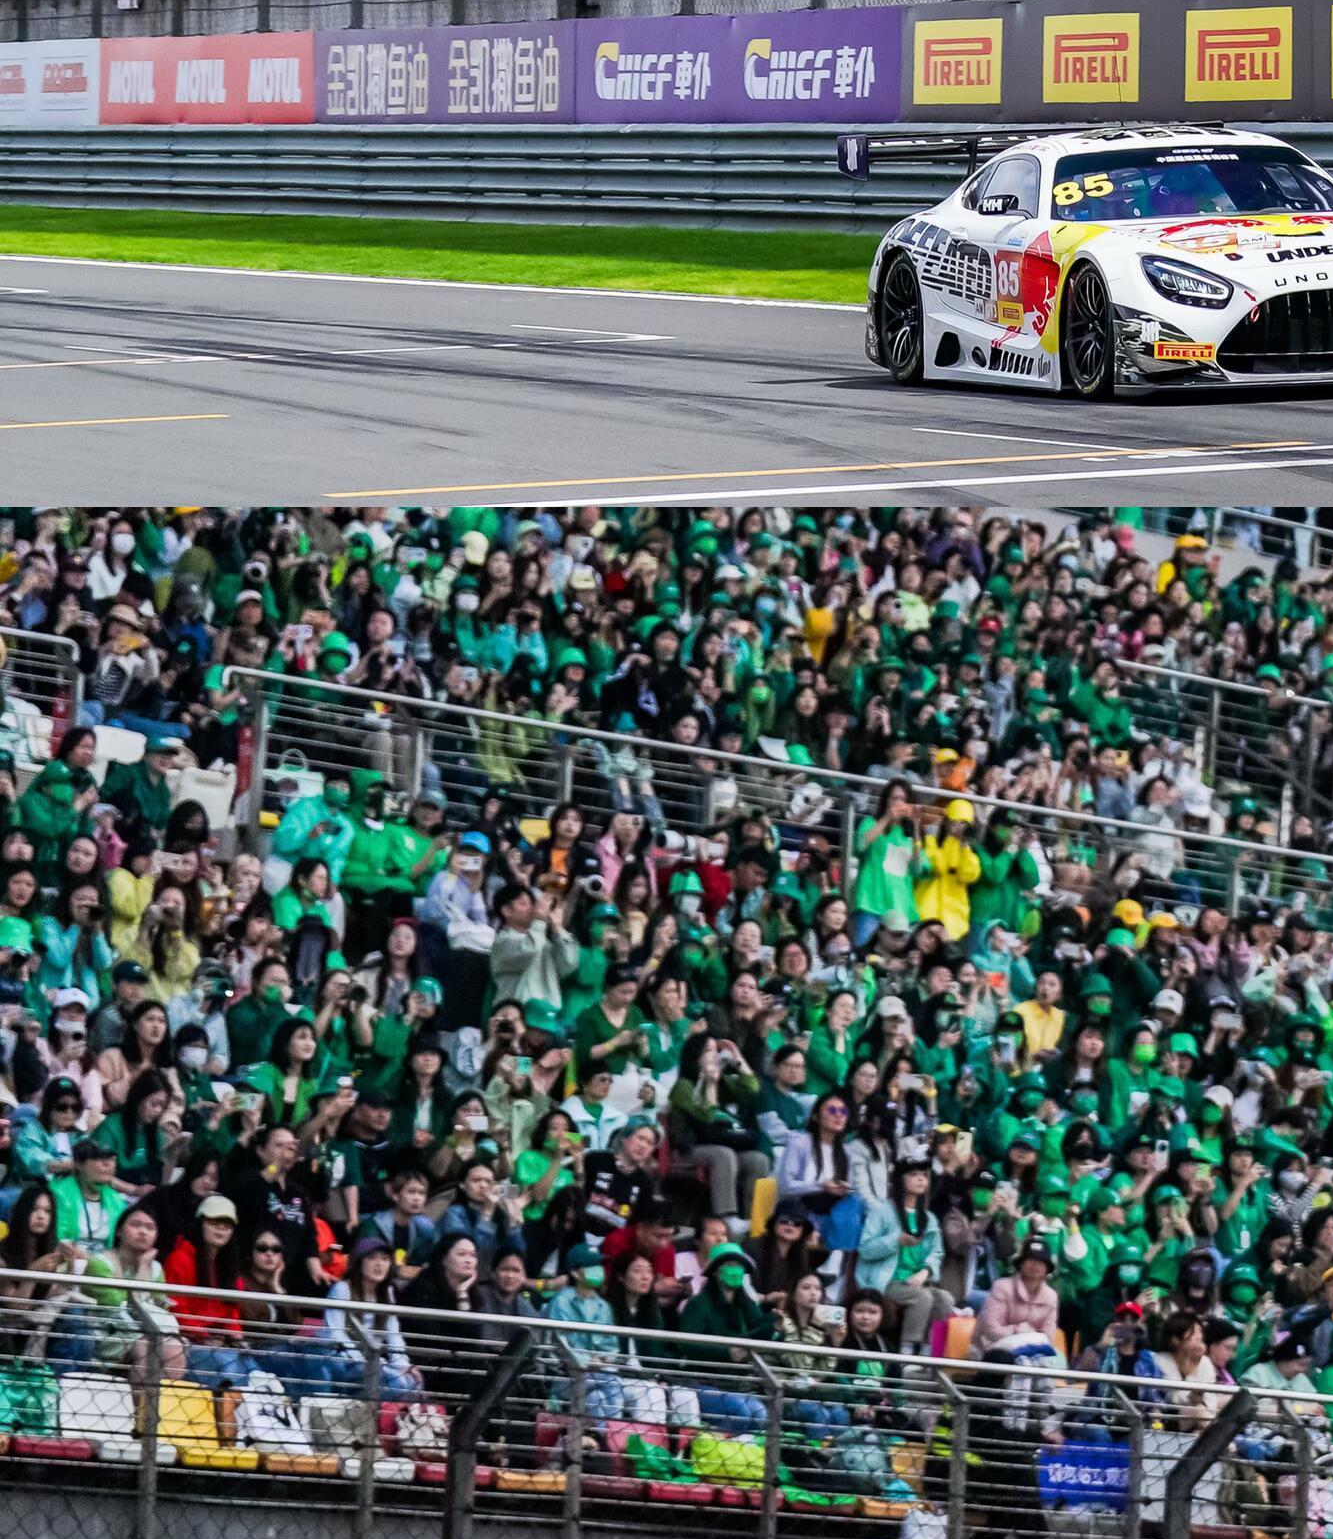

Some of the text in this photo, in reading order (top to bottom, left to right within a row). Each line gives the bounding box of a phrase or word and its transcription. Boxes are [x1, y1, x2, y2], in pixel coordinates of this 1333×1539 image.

[924, 37, 992, 86] PIRELLI
[1054, 33, 1128, 83] PIRELLI
[1197, 27, 1280, 80] PIRELLI
[108, 60, 155, 103] MOTUL
[176, 59, 226, 103] MOTUL
[247, 58, 301, 103] MOTUL
[1053, 173, 1114, 206] 85
[1000, 262, 1019, 296] 85
[1158, 344, 1212, 357] PIRELLI
